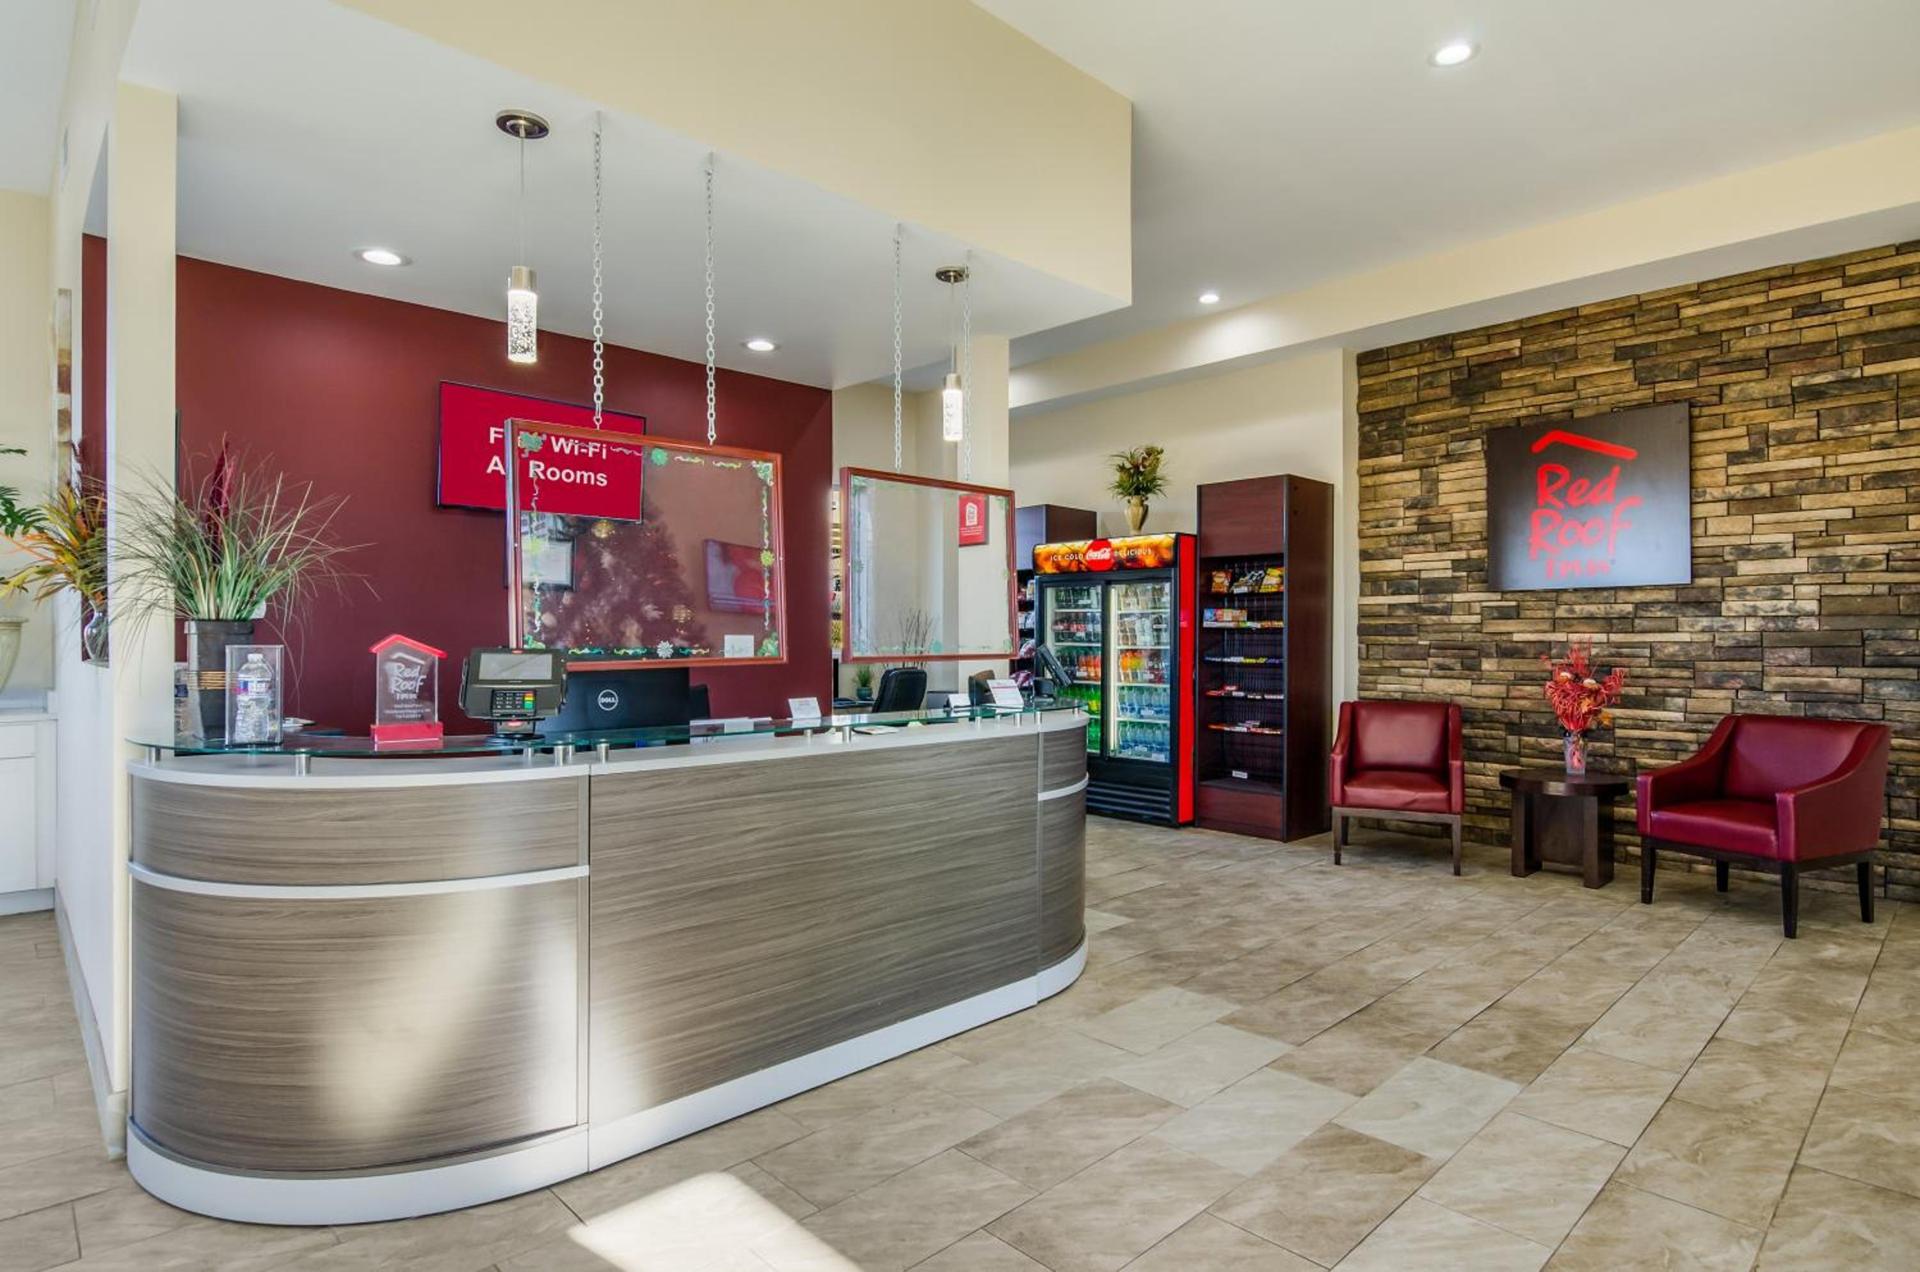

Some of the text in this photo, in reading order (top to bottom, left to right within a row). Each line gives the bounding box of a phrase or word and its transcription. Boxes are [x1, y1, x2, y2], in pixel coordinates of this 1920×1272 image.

[550, 436, 607, 460] Wi-Fi
[528, 460, 608, 487] Rooms
[1536, 463, 1621, 510] Red
[1528, 495, 1645, 561] Roof
[391, 662, 421, 680] Red
[390, 675, 427, 693] Roof
